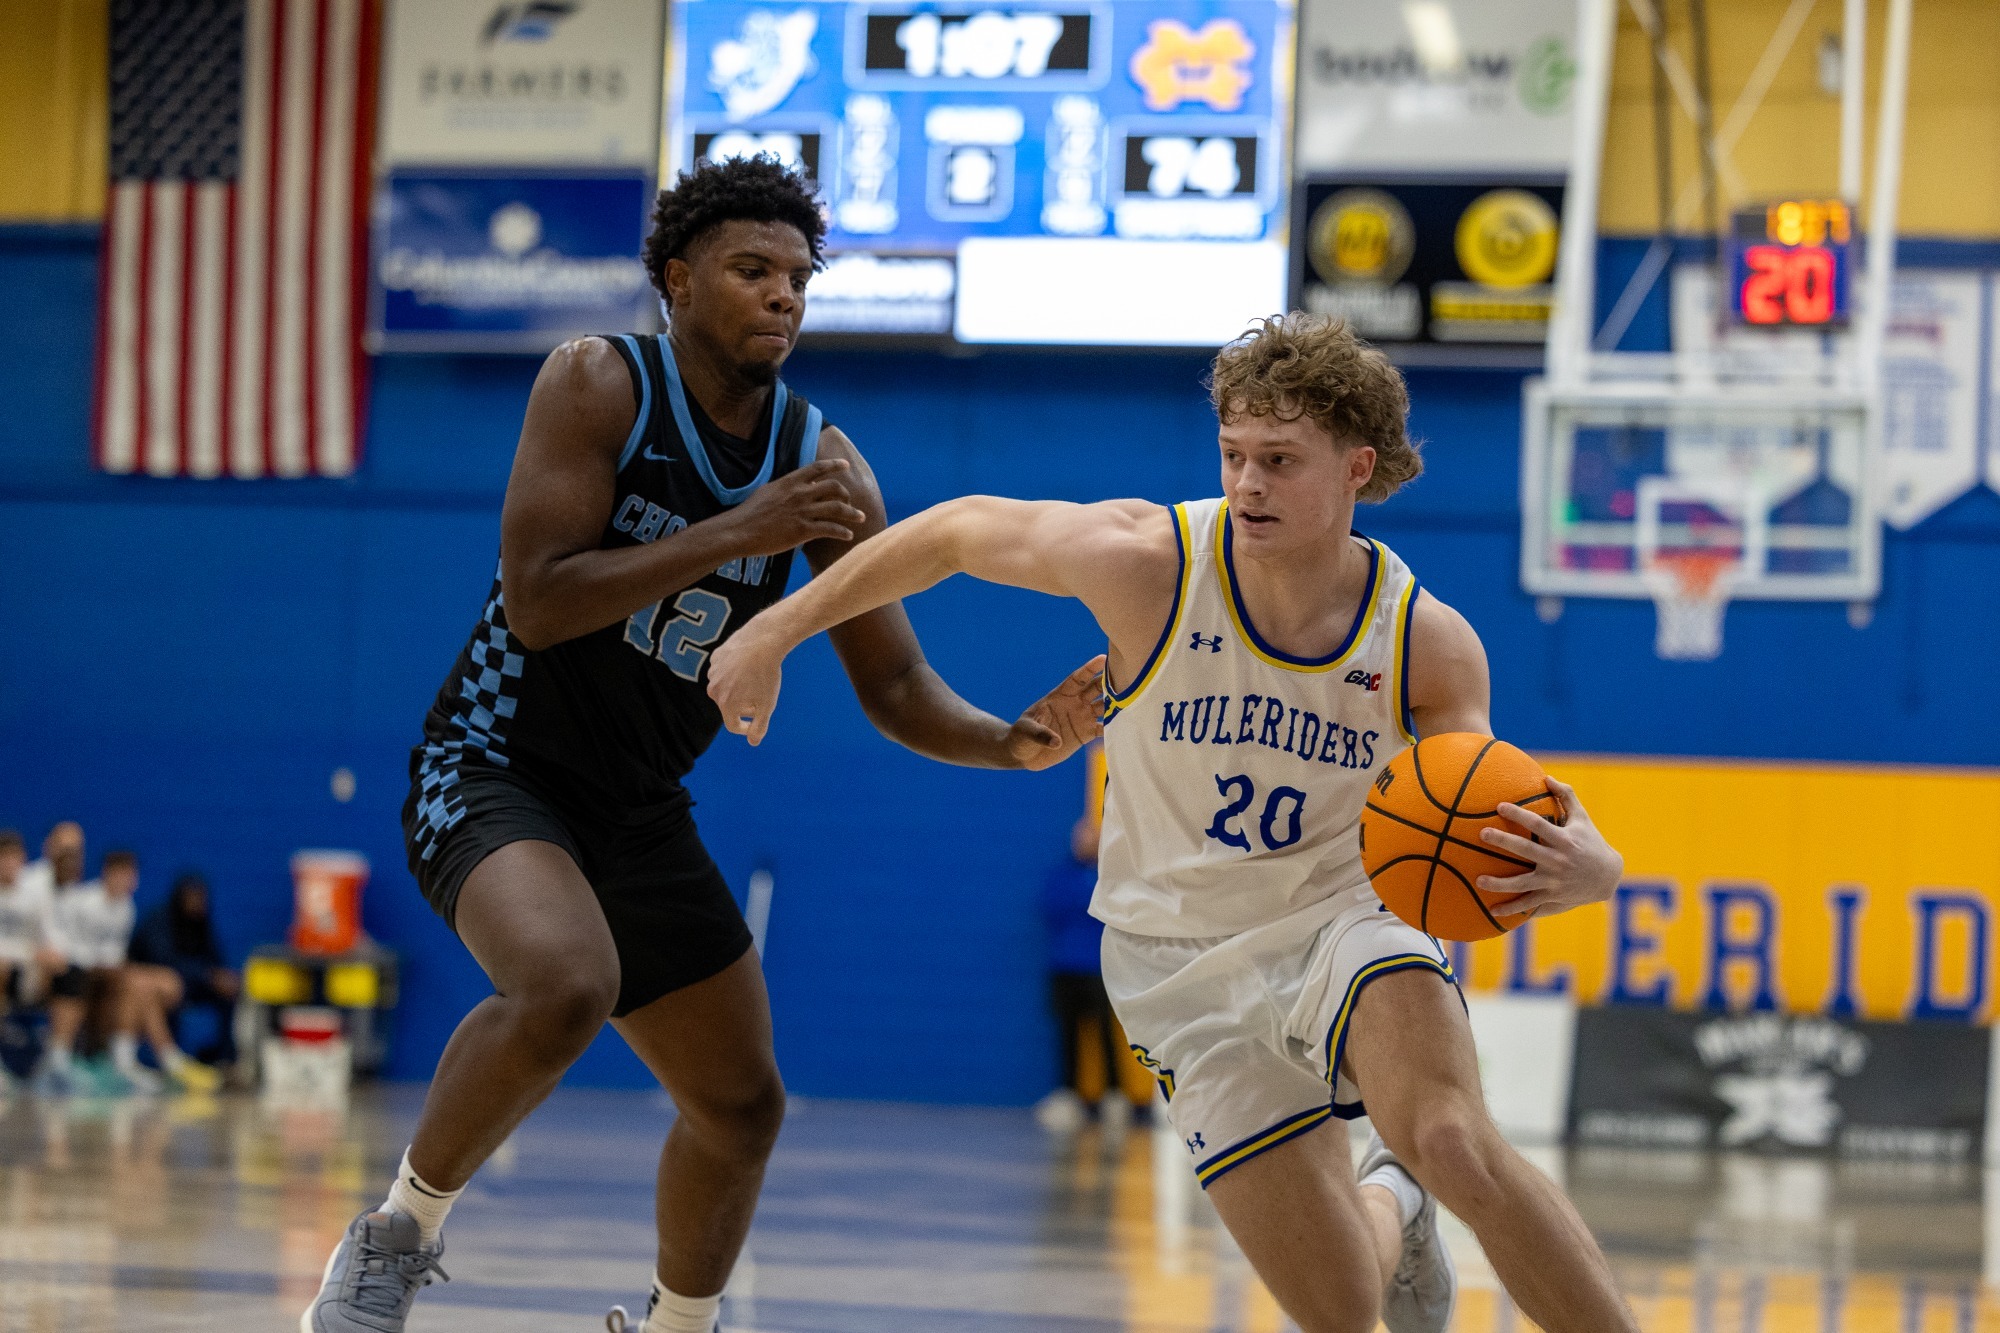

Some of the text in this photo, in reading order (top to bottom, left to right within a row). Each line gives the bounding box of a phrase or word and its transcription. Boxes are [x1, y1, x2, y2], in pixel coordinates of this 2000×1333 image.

[896, 12, 1064, 78] 1:07
[1141, 136, 1241, 198] 74
[1741, 246, 1836, 323] 20
[623, 587, 732, 683] 12
[1344, 670, 1382, 691] GAC
[1160, 694, 1379, 770] MULERIDERS
[1205, 773, 1306, 852] 20
[1451, 878, 1991, 1024] LERID
